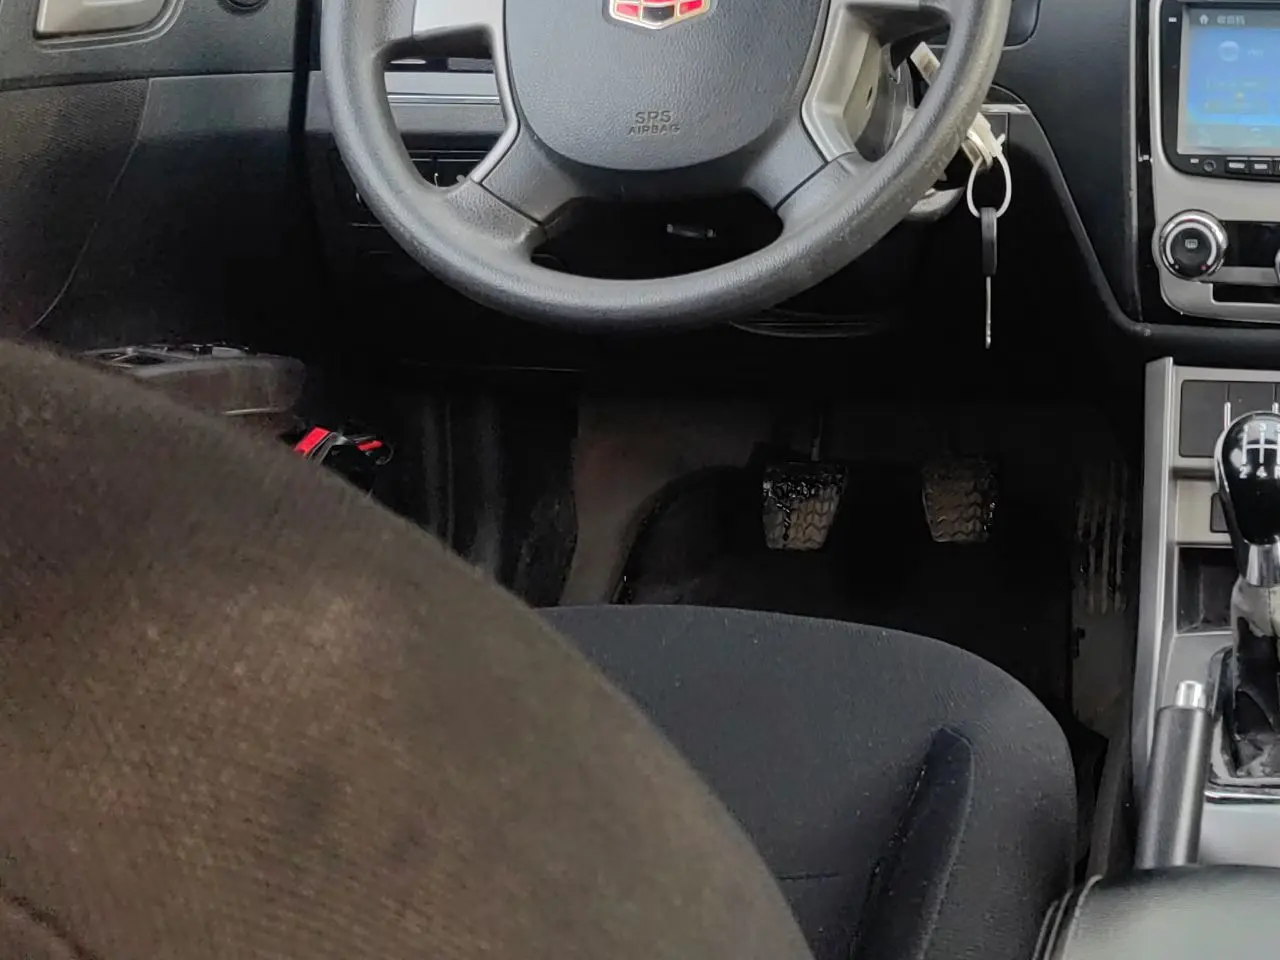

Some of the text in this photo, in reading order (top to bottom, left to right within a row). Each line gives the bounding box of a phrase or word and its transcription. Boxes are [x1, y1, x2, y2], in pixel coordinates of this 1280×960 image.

[627, 123, 681, 136] AIRBAG
[1259, 422, 1267, 431] 3
[1239, 467, 1248, 479] 2
[1256, 466, 1267, 478] 4
